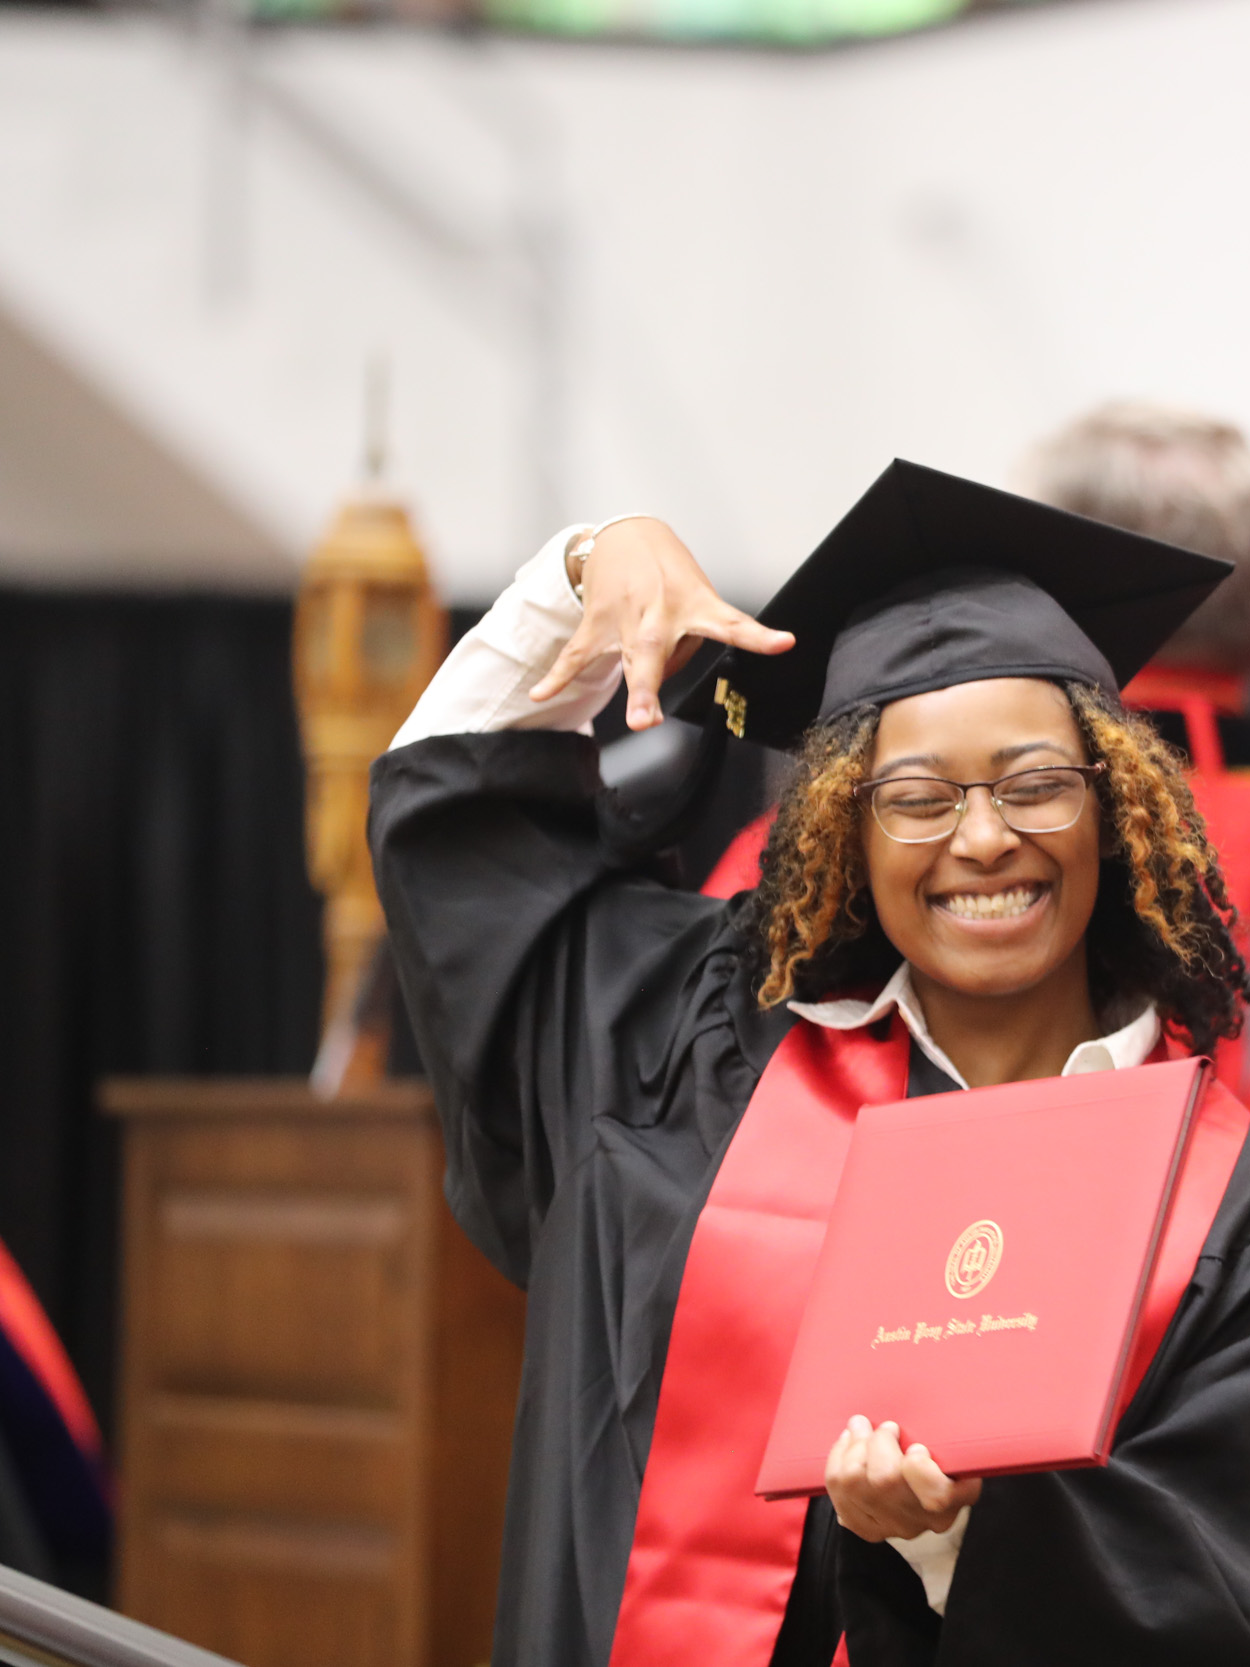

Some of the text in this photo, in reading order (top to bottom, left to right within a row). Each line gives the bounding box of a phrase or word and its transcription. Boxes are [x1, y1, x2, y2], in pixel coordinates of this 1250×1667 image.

[870, 1326, 911, 1350] Austin
[942, 1317, 977, 1340] State
[975, 1312, 1038, 1338] University
